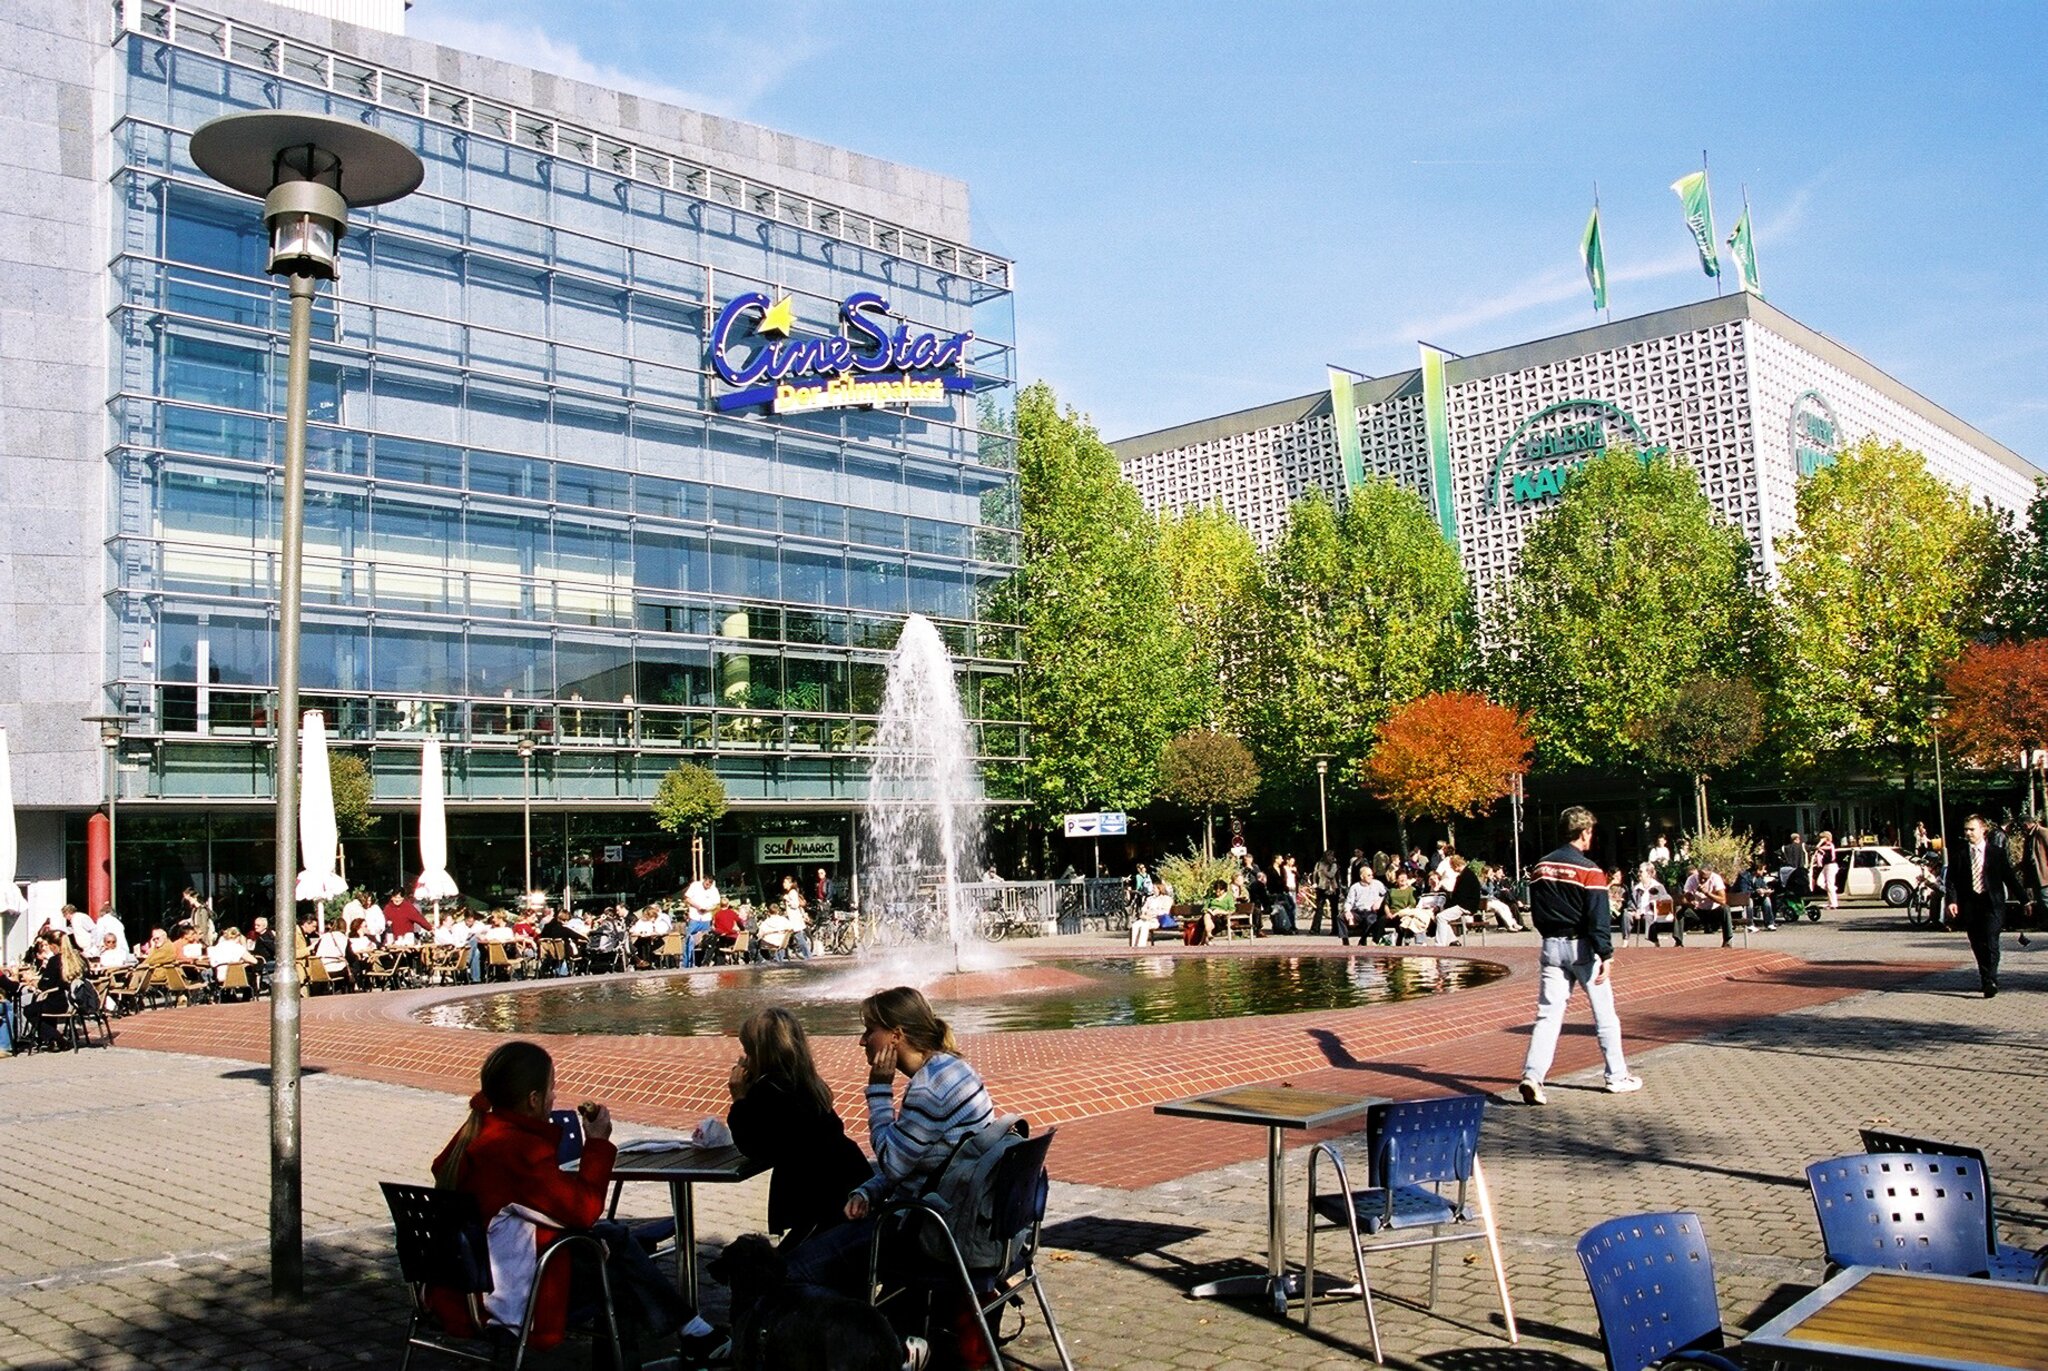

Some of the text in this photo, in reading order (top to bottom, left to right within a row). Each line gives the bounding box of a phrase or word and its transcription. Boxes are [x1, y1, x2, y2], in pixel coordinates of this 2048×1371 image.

[711, 291, 976, 387] CineStar
[776, 372, 944, 408] Der Filmpalast
[1525, 420, 1607, 460] GALERIA
